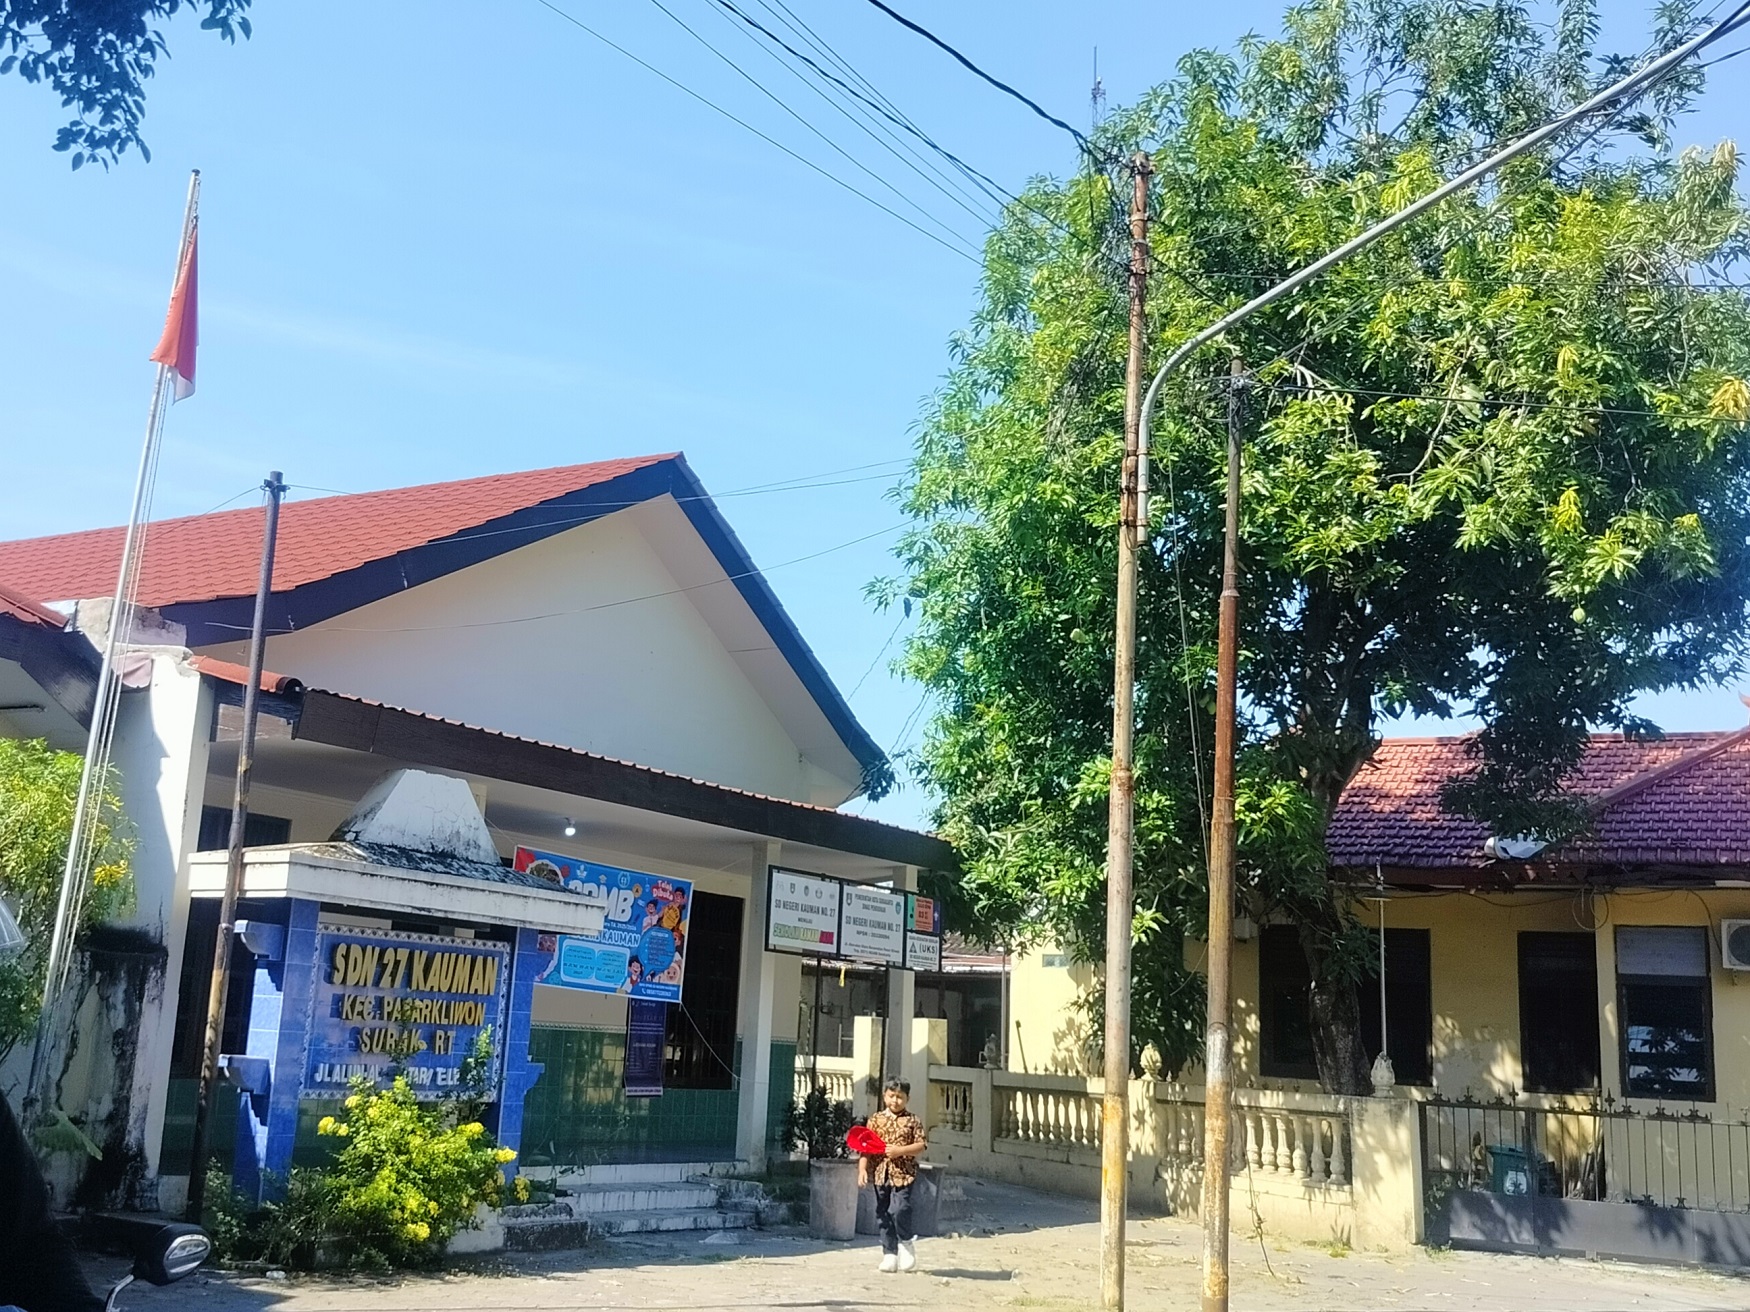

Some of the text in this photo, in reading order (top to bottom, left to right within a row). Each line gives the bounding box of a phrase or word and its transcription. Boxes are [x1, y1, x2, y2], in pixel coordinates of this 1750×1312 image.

[774, 899, 781, 909] SD
[782, 900, 800, 912] NEGERI
[800, 903, 820, 915] KAUMAN
[829, 908, 836, 918] 27
[845, 915, 852, 925] SD
[852, 916, 868, 927] NEGERI
[869, 919, 887, 930] KAUMAN
[895, 923, 901, 933] 27
[601, 929, 641, 947] KAUMAN
[919, 943, 938, 955] (UKS)
[333, 943, 498, 995] SDN 27 KAUMAN
